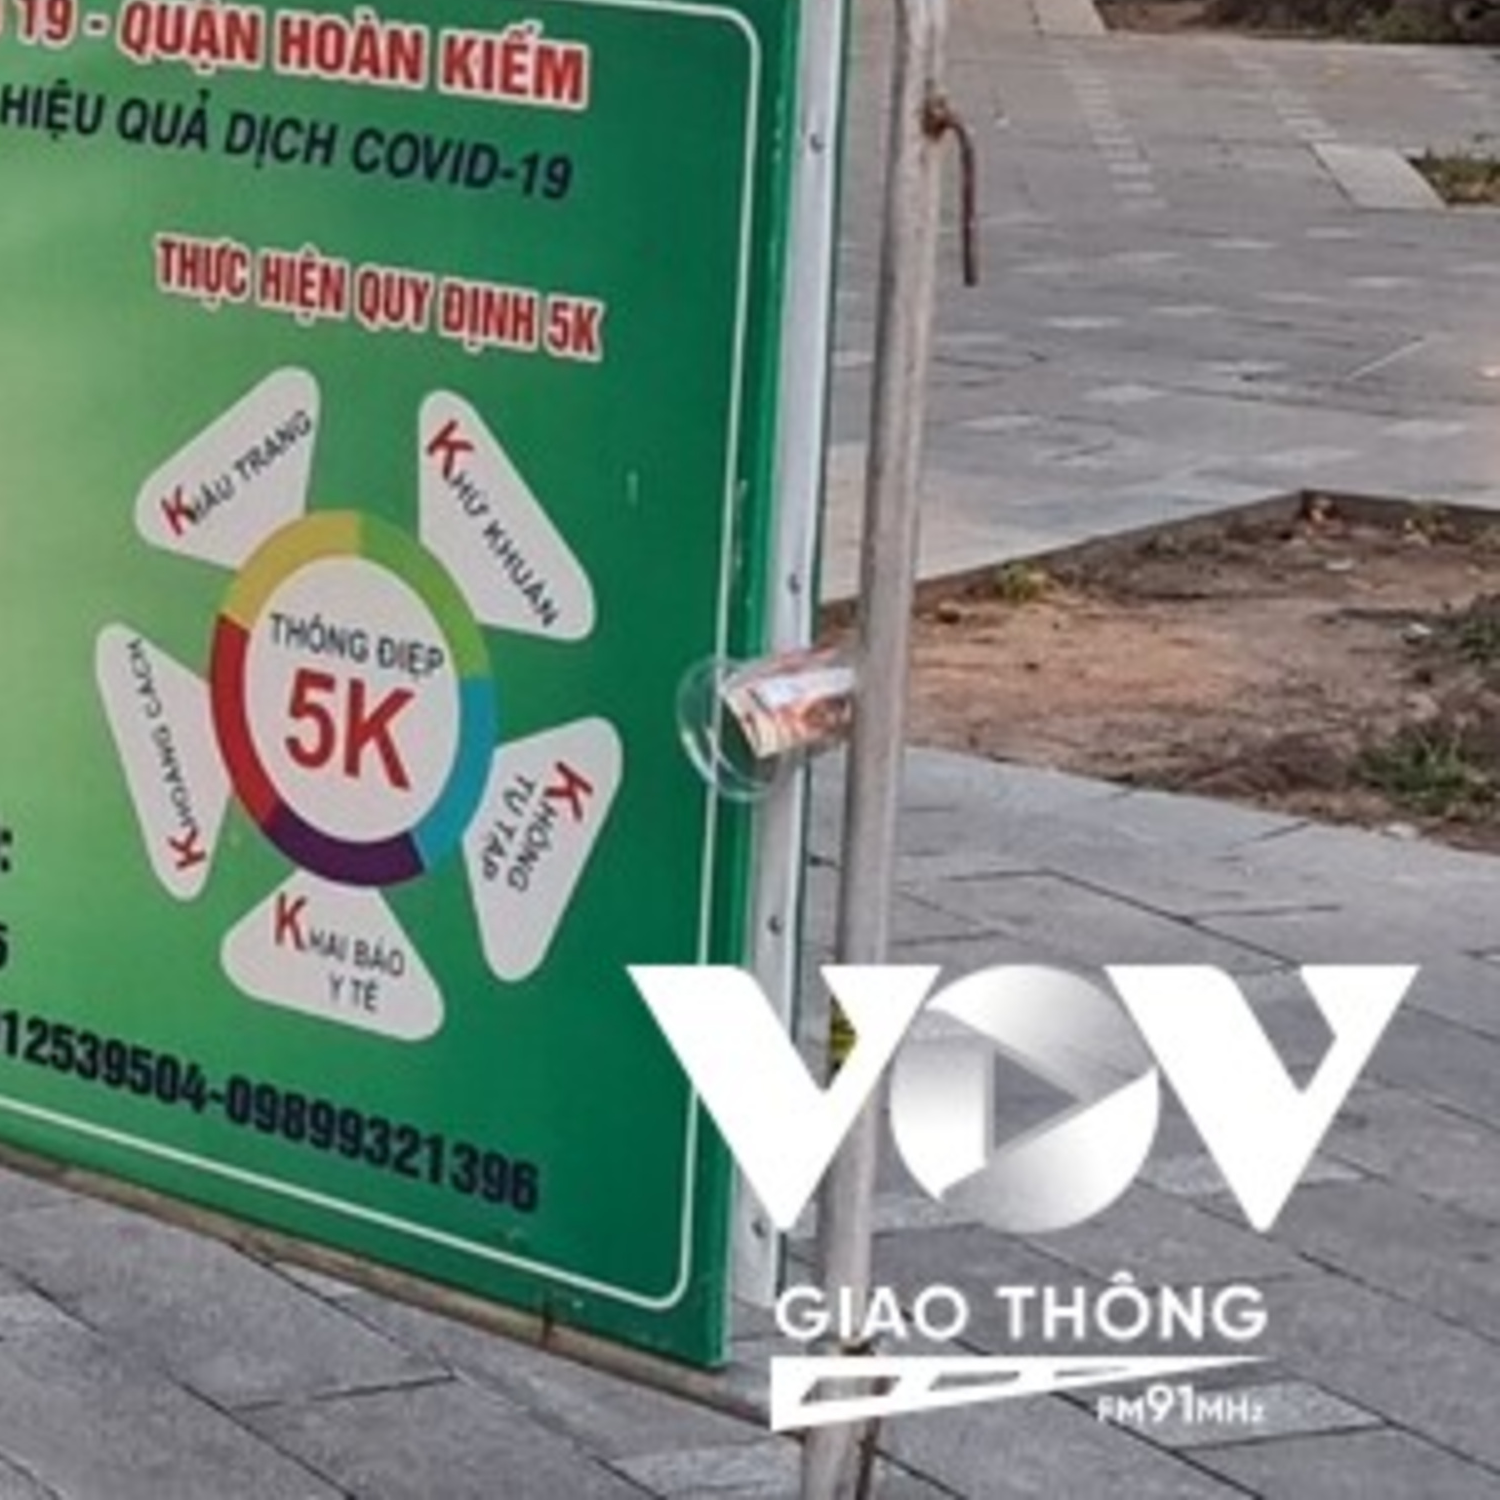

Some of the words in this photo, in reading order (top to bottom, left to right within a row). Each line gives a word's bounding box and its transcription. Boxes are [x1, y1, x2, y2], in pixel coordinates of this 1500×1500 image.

[274, 4, 427, 90] HOÀN
[438, 18, 589, 110] KIẾM
[0, 78, 104, 140] HIỆU
[116, 89, 211, 151] QUẢ
[224, 110, 337, 170] DỊCH
[349, 127, 573, 200] COVID-19
[155, 232, 251, 310] THỰC
[257, 244, 348, 322] HIỆN
[355, 266, 436, 331] QUY
[440, 280, 539, 354] ĐỊNH
[543, 297, 604, 362] 5K
[284, 667, 416, 791] 5K
[329, 974, 344, 1002] Y
